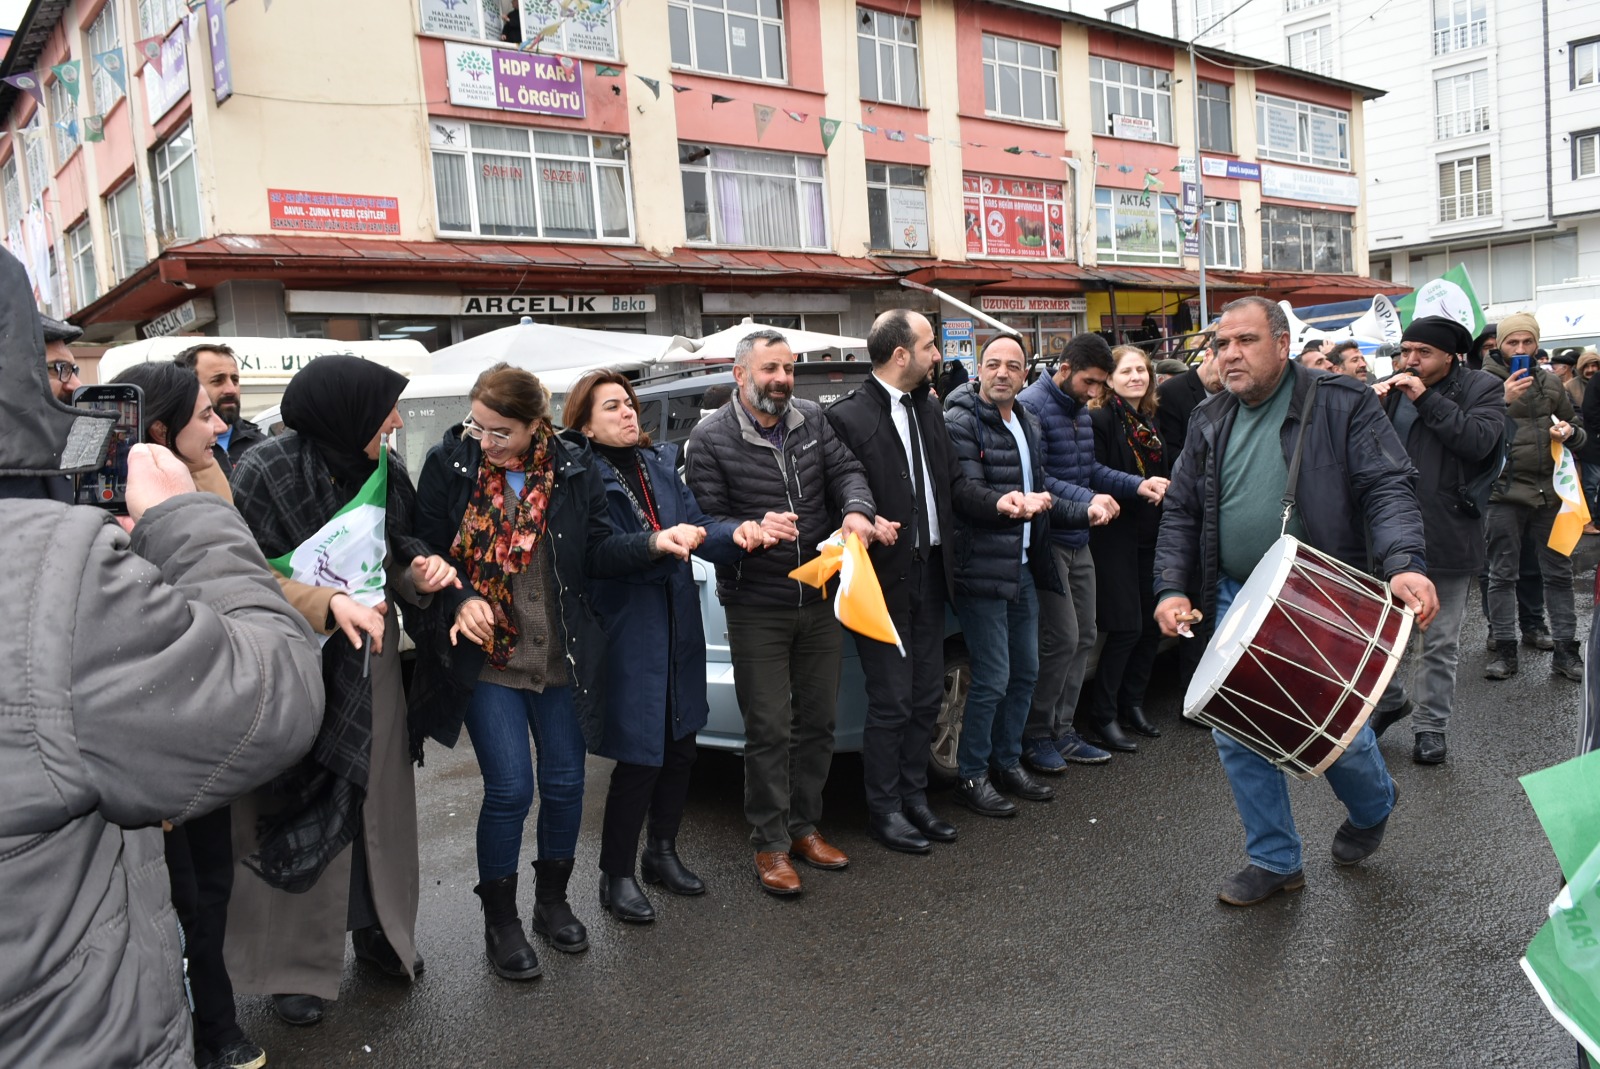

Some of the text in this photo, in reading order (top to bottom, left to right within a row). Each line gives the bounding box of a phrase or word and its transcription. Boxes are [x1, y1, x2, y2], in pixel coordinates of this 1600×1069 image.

[431, 10, 471, 21] HALKLARIN
[499, 58, 531, 77] HDP
[499, 82, 580, 110] İL ÖRGÜTÜ
[1120, 193, 1151, 208] AKTAŞ
[283, 205, 305, 216] DAVUL
[309, 206, 331, 217] ZURNA
[331, 207, 340, 218] VE
[341, 207, 356, 219] DERİ
[356, 208, 387, 221] ÇEŞİTLERİ
[464, 294, 646, 316] ARÇELİK Beko
[982, 297, 1026, 311] UZUNGİL
[1028, 299, 1070, 311] MERMER
